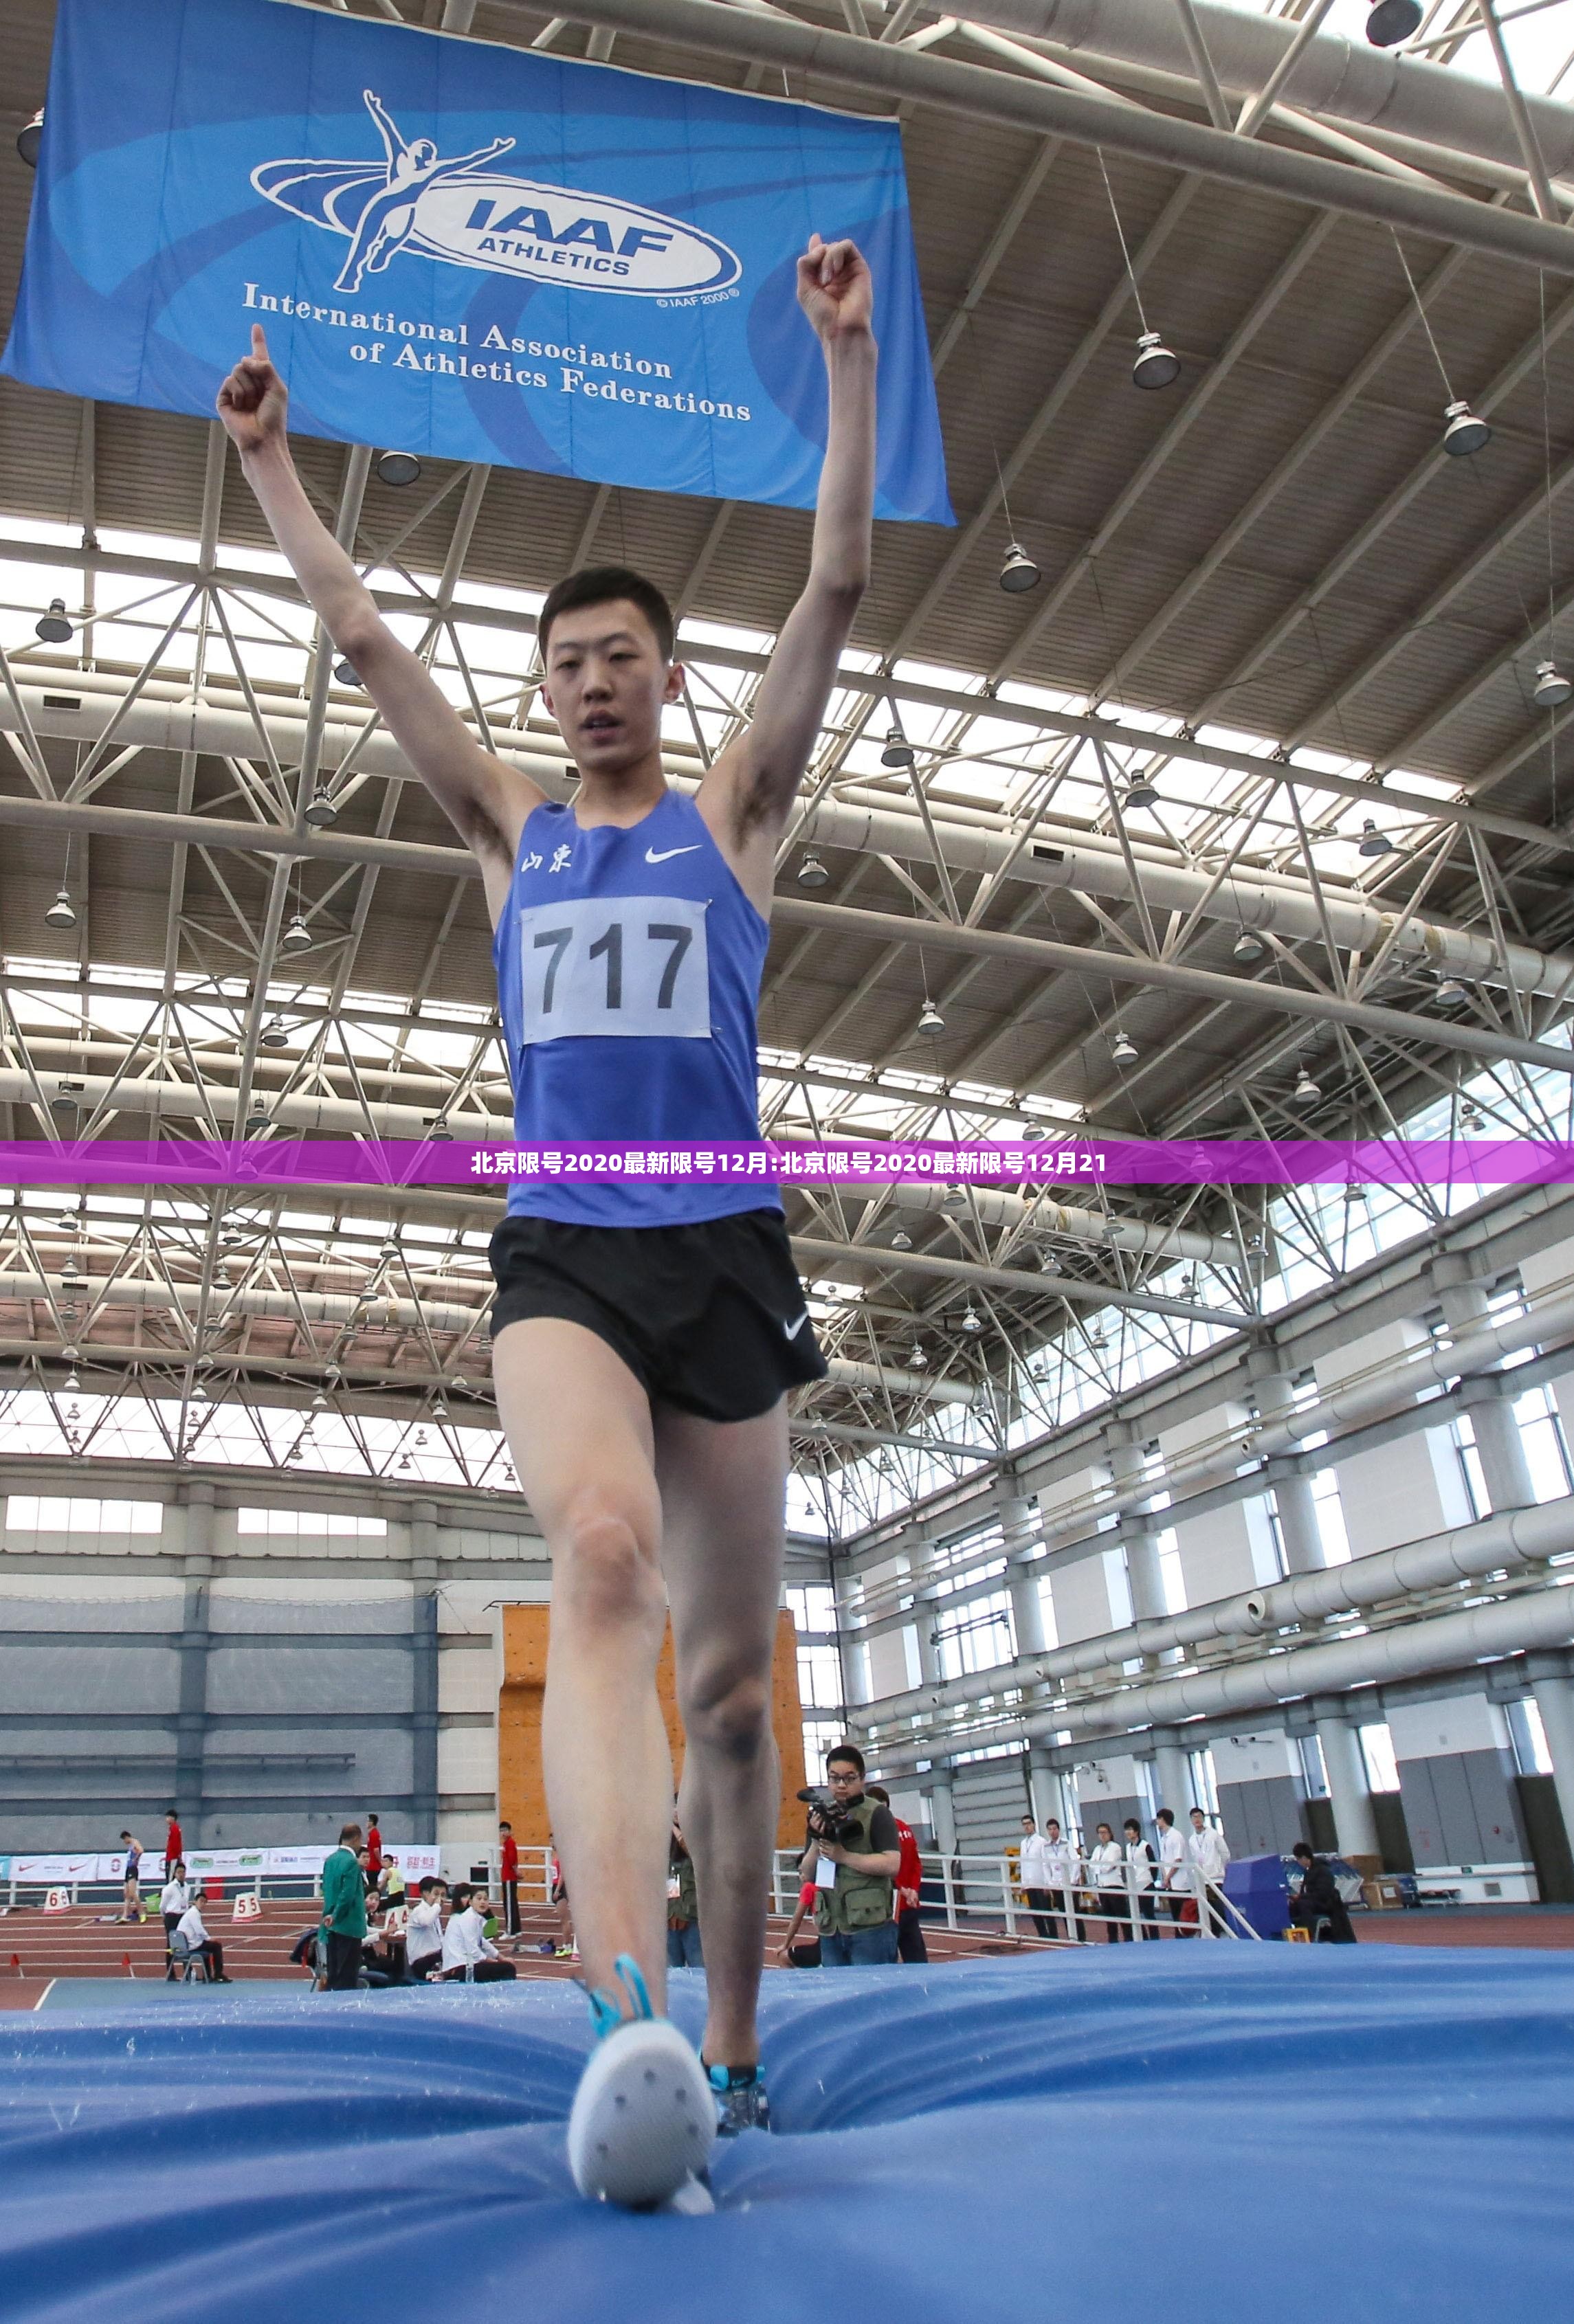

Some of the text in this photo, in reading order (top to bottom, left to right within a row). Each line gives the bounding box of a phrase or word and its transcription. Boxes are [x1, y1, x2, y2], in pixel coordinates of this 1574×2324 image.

[465, 199, 674, 258] IAAF
[477, 237, 630, 276] ATHLETICS
[242, 282, 672, 379] International Association
[349, 343, 751, 422] of Athletics Federations
[534, 923, 693, 1014] 717
[49, 1892, 58, 1906] 6
[239, 1899, 246, 1913] 5
[250, 1897, 257, 1911] 5
